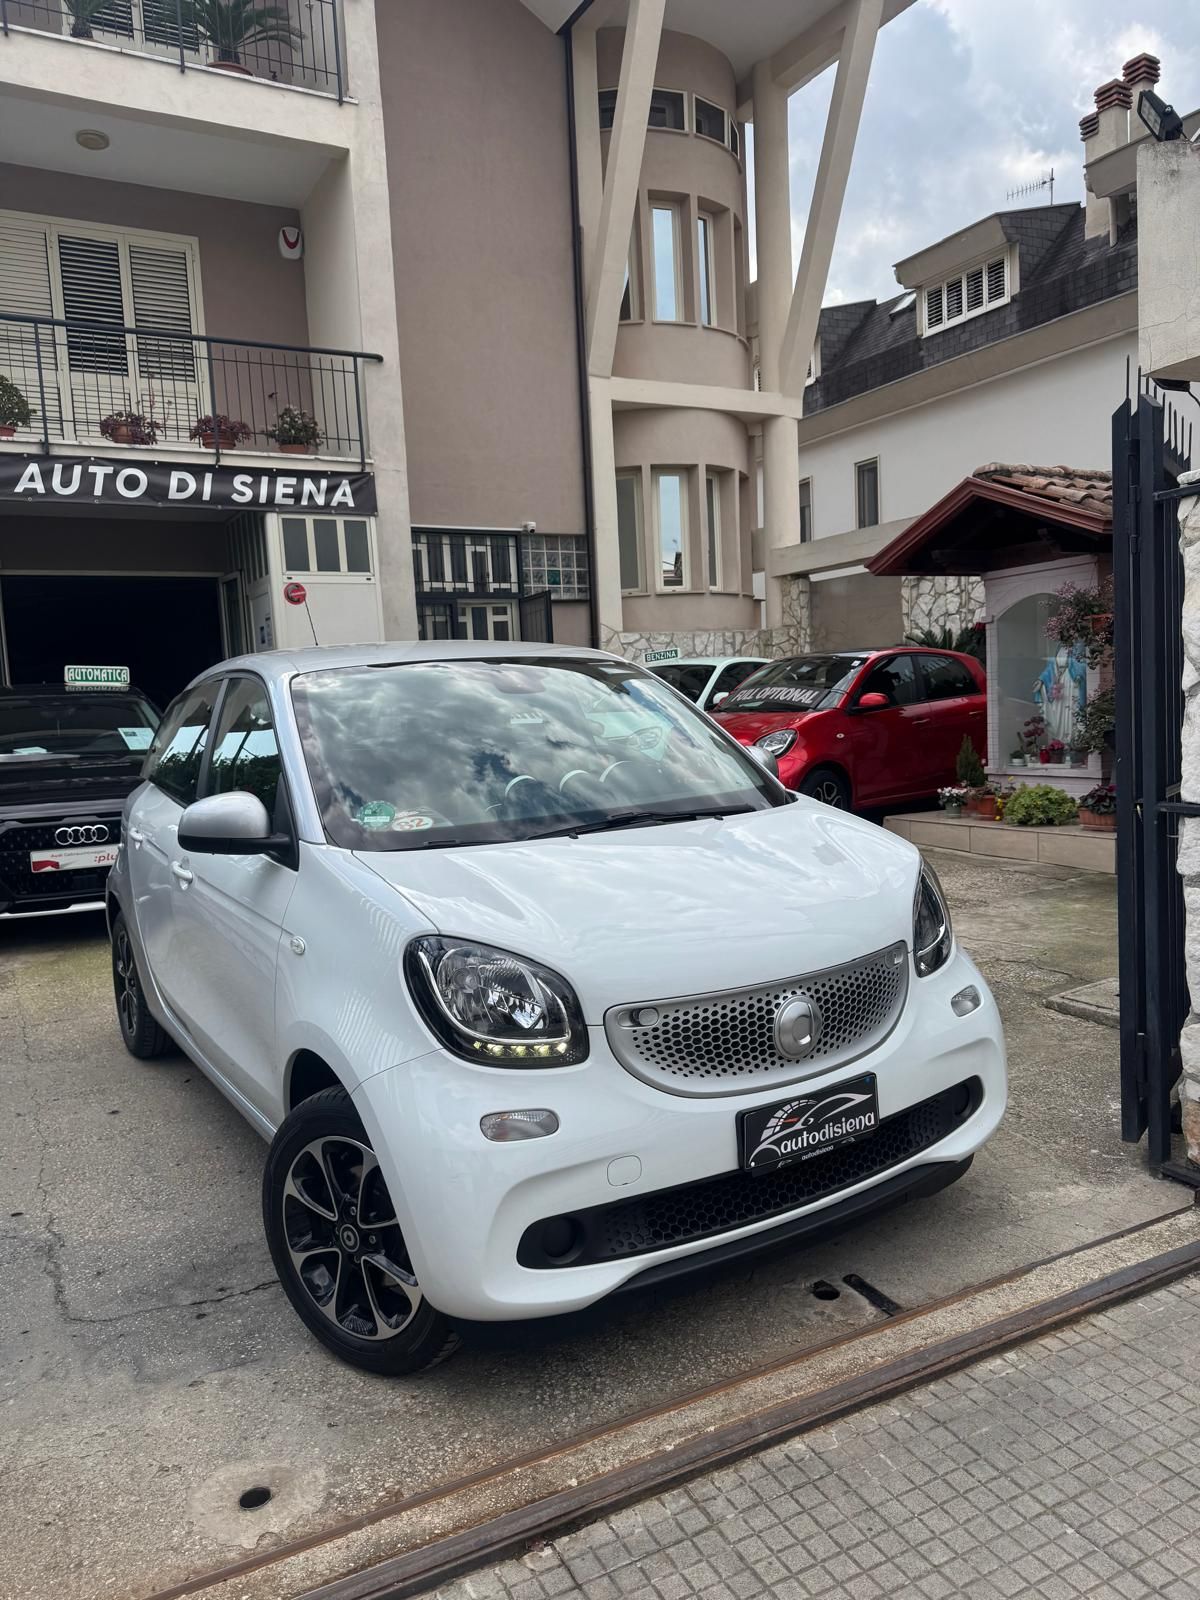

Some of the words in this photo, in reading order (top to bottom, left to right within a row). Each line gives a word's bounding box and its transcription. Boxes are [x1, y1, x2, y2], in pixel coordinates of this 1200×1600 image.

[14, 462, 148, 499] AUTO
[168, 470, 212, 502] DI
[231, 473, 356, 508] SIENA
[646, 650, 677, 662] BENZINA
[68, 668, 128, 682] AUTOMATICA
[731, 687, 759, 702] FULL
[755, 686, 820, 704] OPTIONAL
[780, 1111, 875, 1154] autodisiena
[801, 1145, 834, 1161] autodisiena
